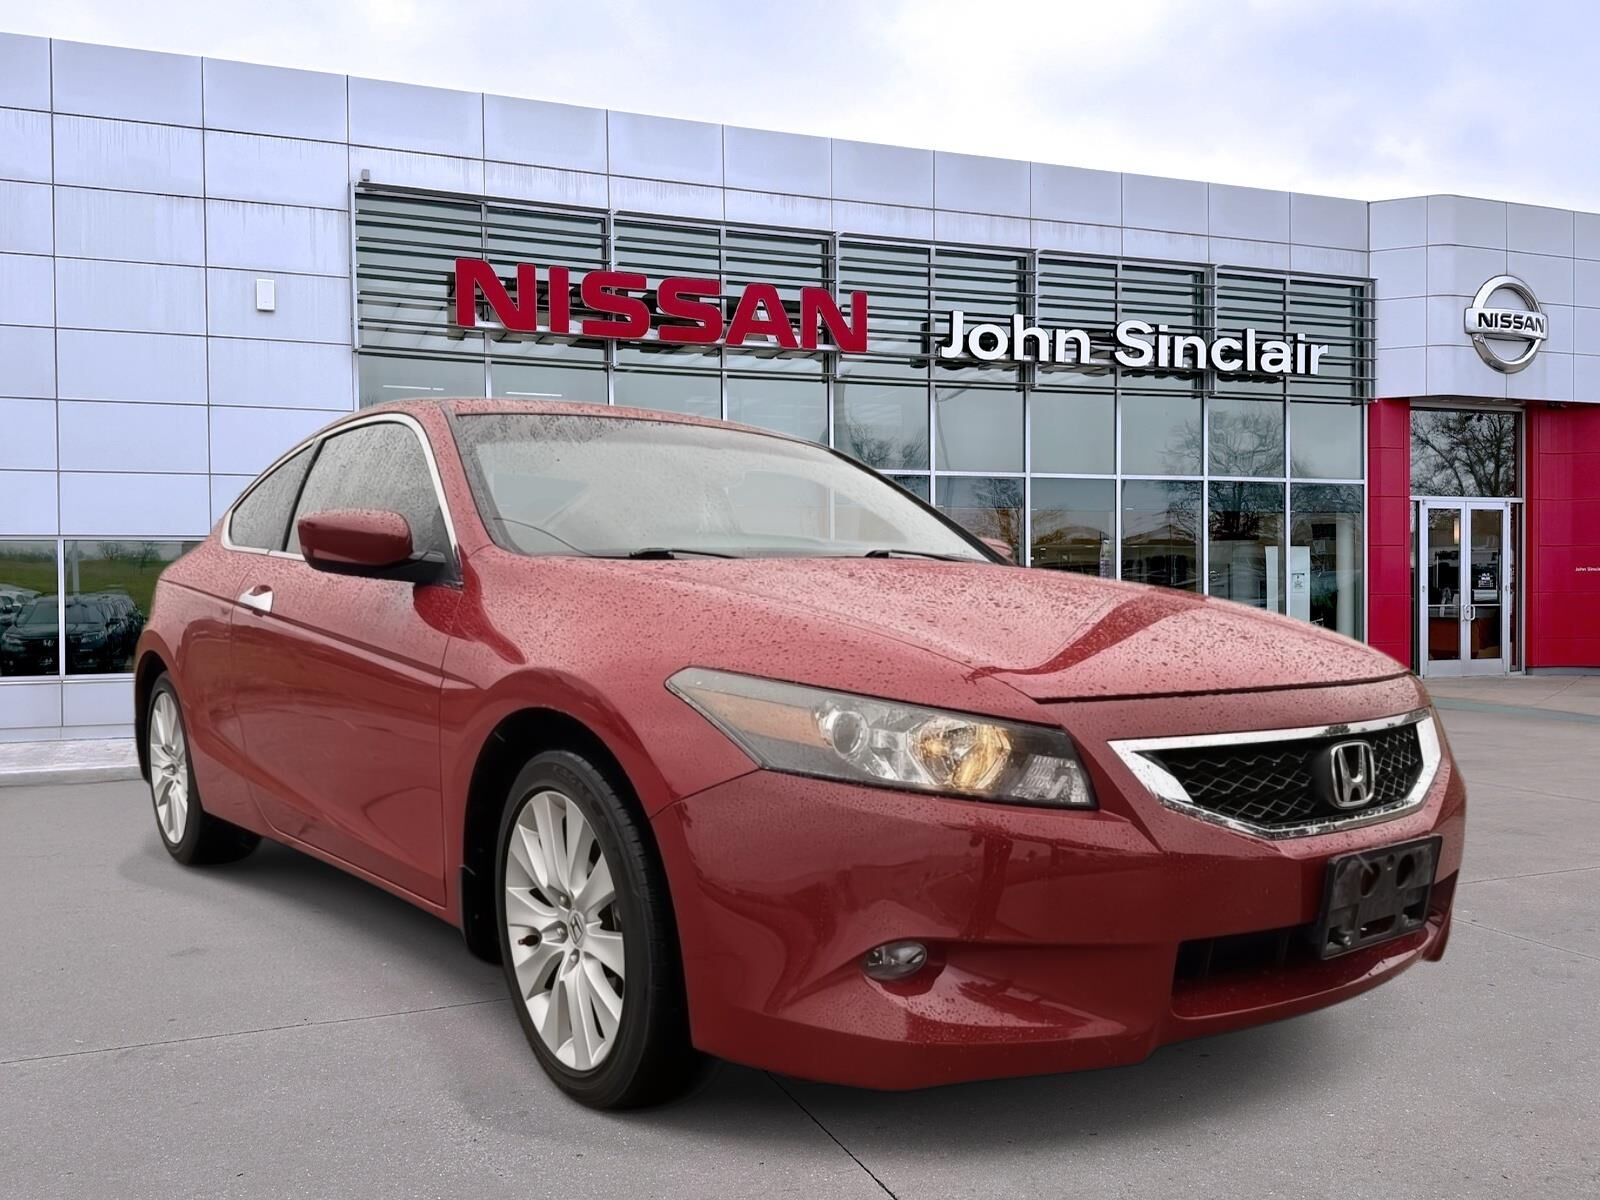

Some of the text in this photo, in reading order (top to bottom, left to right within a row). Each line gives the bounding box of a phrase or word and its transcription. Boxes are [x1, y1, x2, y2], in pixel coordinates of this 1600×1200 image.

[455, 257, 868, 353] NISSAN
[1477, 312, 1545, 334] NISSAN
[941, 310, 1329, 375] John Sinclair
